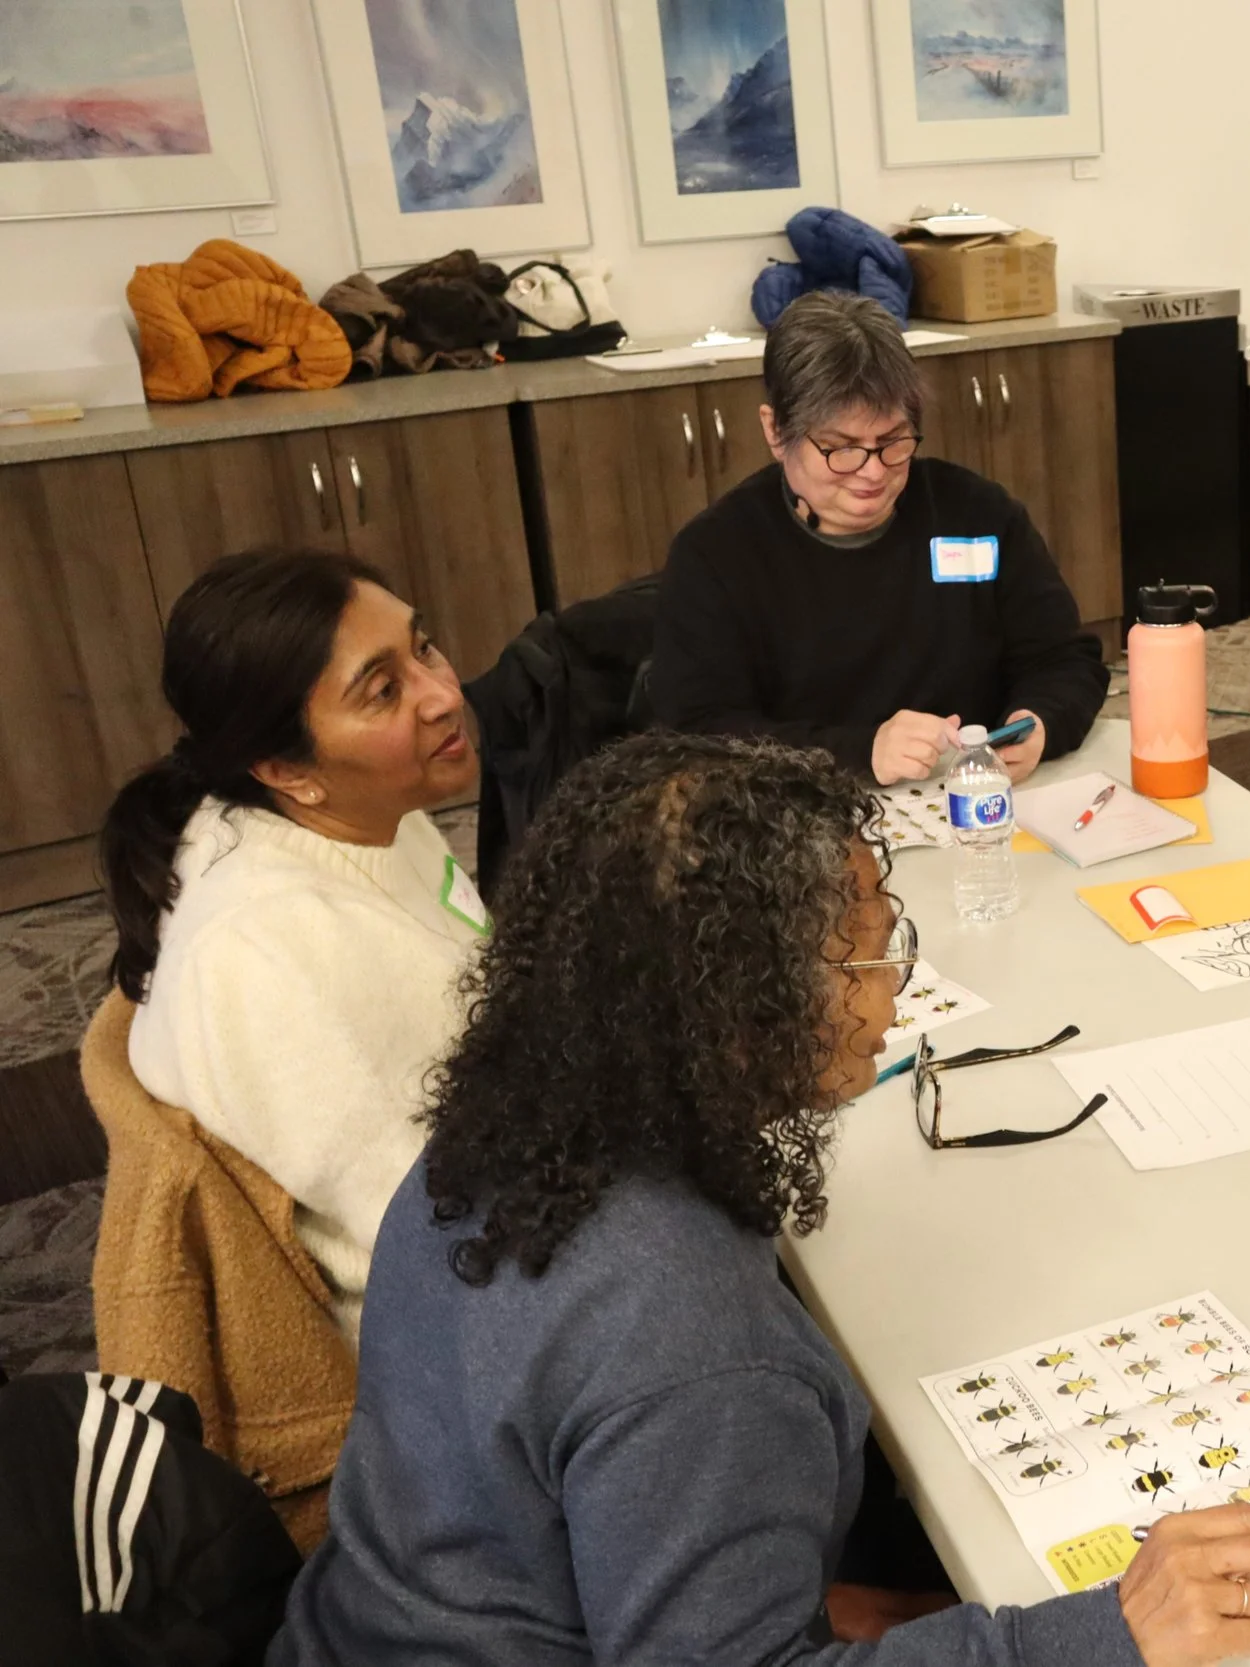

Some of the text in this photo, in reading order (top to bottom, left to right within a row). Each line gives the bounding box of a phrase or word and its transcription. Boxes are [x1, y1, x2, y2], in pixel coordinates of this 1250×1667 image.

[1141, 297, 1205, 319] WASTE
[980, 795, 1003, 807] Pure
[984, 803, 1001, 816] Life
[1198, 1298, 1223, 1321] BUMBLE
[1220, 1320, 1237, 1335] BEES
[1234, 1335, 1246, 1345] OF
[1005, 1376, 1043, 1421] CUCKOO BEES
